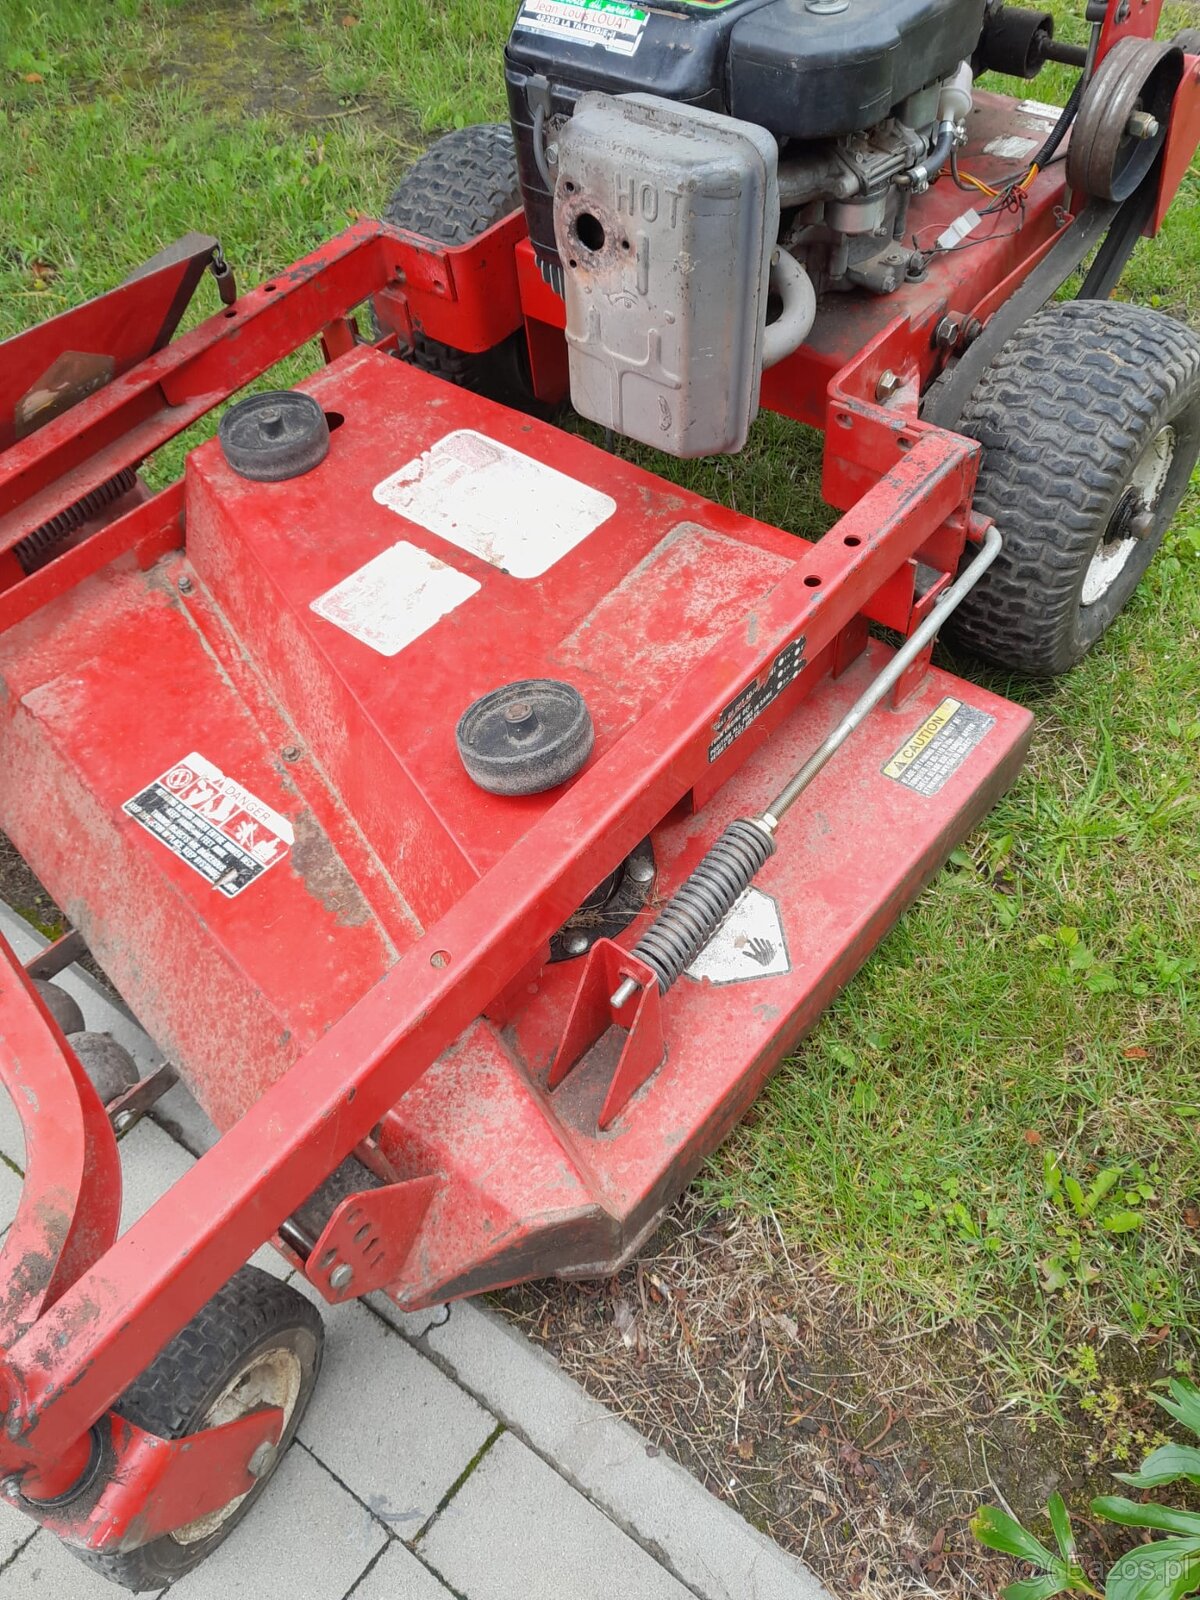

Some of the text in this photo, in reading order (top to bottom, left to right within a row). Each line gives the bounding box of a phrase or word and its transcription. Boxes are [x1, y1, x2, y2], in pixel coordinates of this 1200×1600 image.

[561, 18, 572, 28] LA
[592, 11, 631, 31] LOUAT
[615, 172, 684, 229] HOT
[903, 716, 944, 758] CAUTION
[225, 784, 270, 823] DANGER
